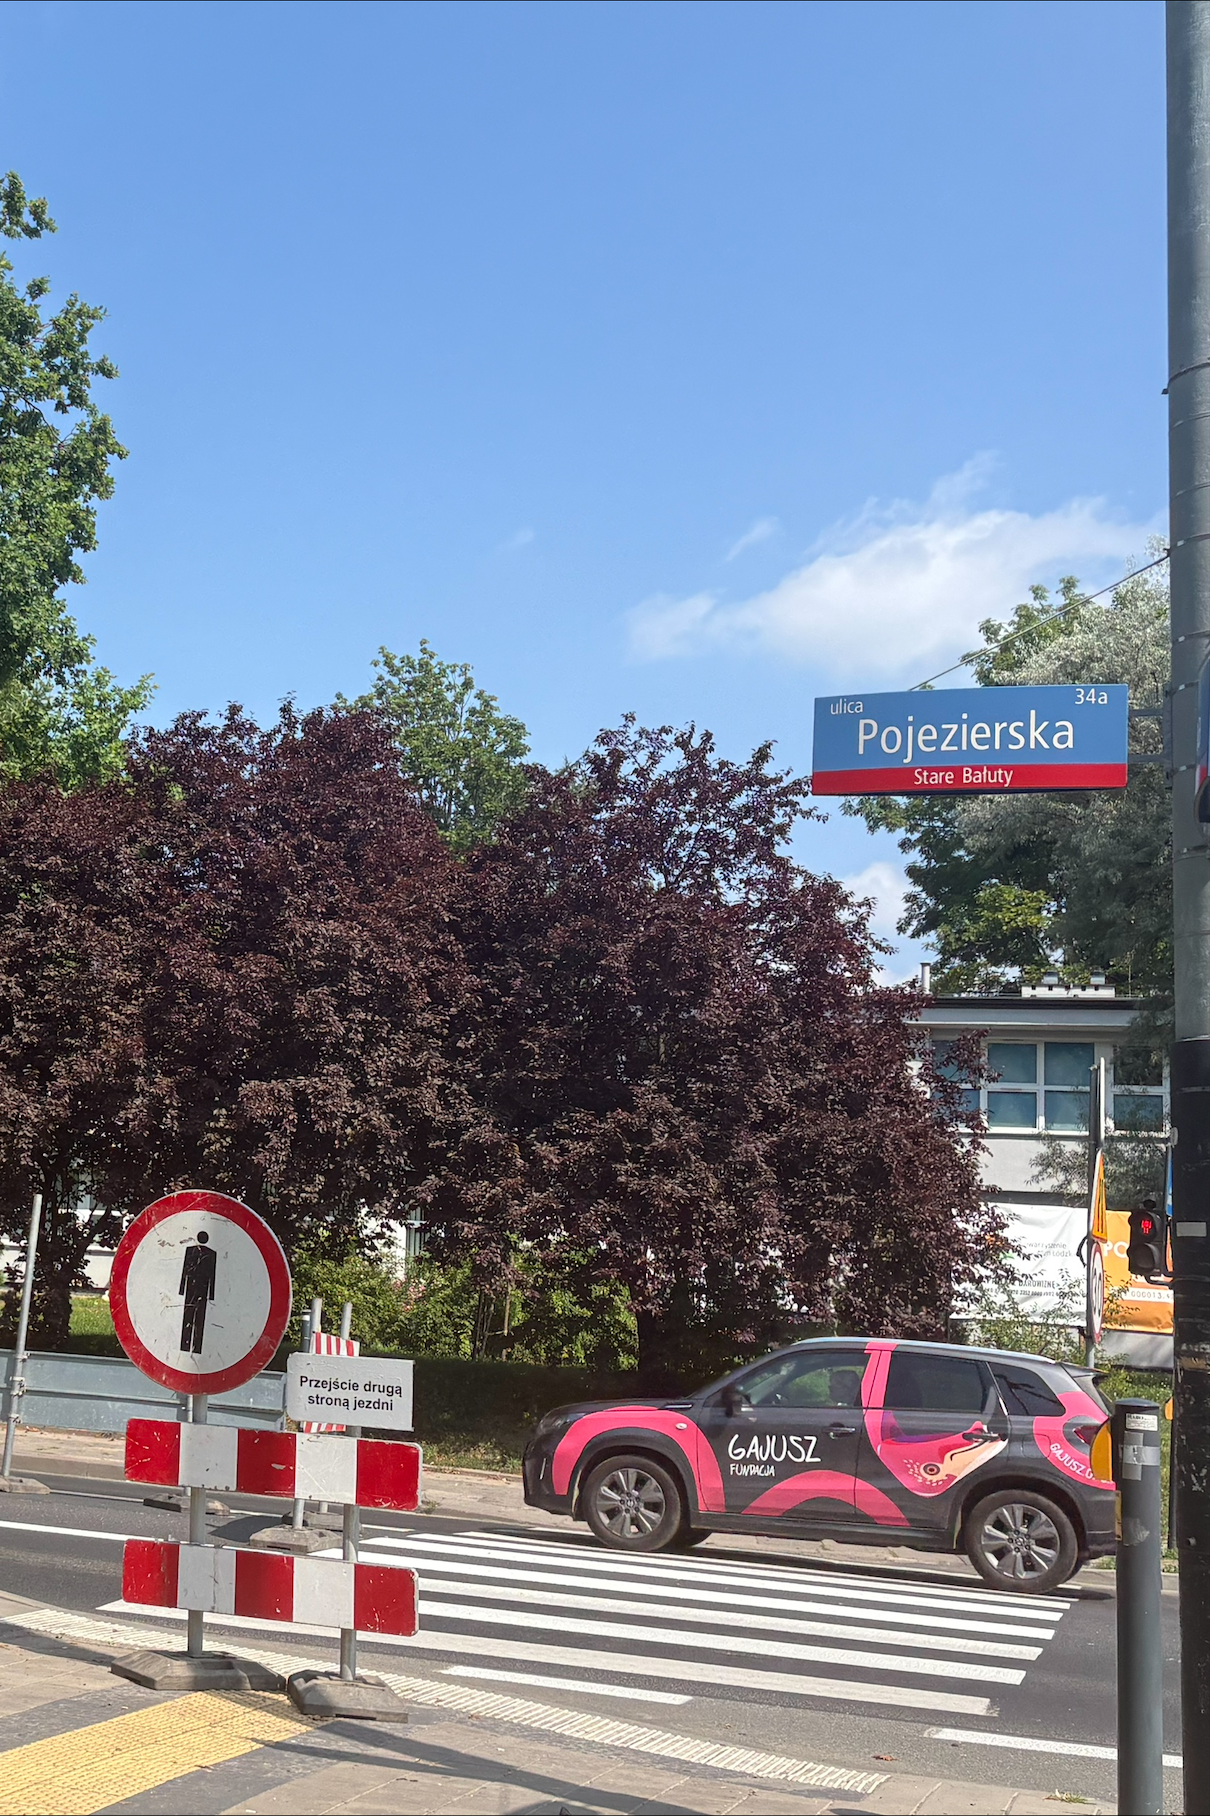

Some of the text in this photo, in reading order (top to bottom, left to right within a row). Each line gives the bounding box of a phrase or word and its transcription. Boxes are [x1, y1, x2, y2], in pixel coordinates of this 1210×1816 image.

[830, 688, 1108, 715] ulica 34a
[858, 709, 1074, 764] Pojezierska
[913, 766, 1013, 787] Stare Bałuty
[300, 1375, 403, 1397] Przejście drugą
[307, 1394, 393, 1411] stroną jezdni
[728, 1433, 821, 1462] GAJUSZ
[730, 1463, 775, 1477] FUNDACJA
